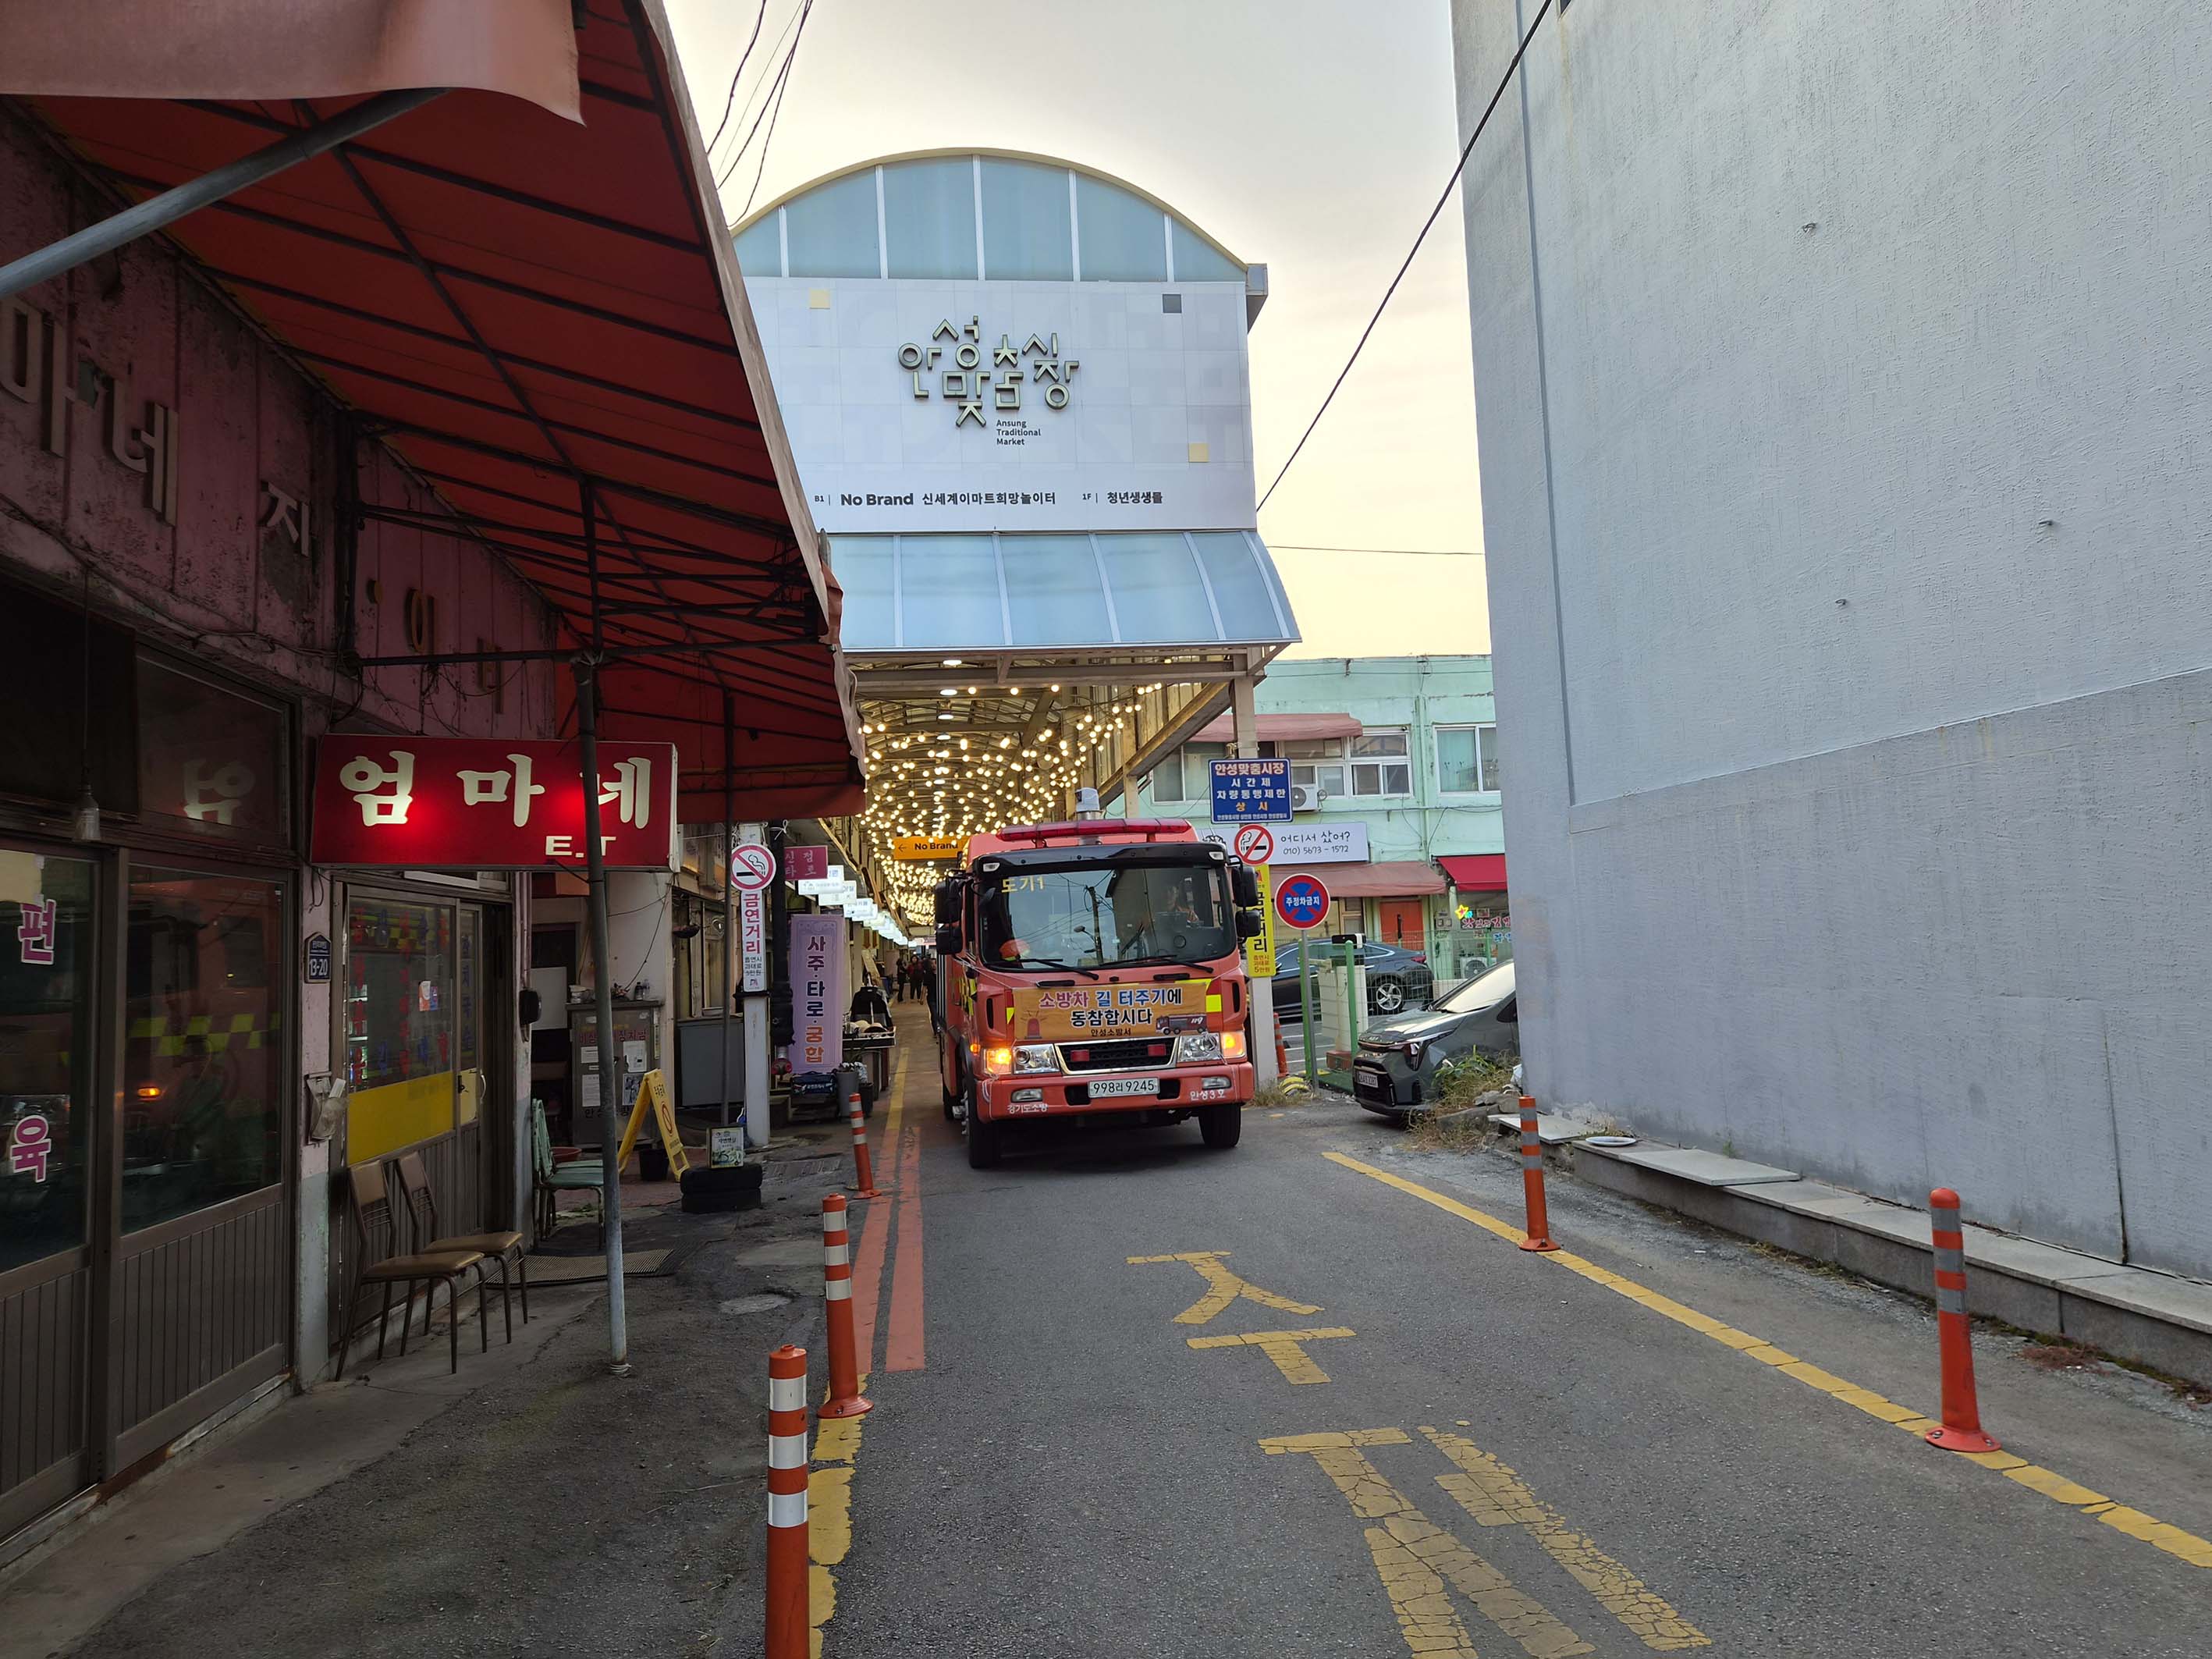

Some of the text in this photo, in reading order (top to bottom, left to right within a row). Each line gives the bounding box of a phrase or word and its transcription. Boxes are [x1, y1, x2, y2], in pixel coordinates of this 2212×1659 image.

[996, 420, 1027, 431] Ansung
[841, 494, 862, 506] No
[866, 493, 914, 506] Brand
[1215, 762, 1285, 776] 안성맞춤시장
[1231, 777, 1271, 787] 시간제
[1216, 789, 1286, 800] 차량통행제한
[1280, 830, 1351, 843] 어디서 샀어?
[1286, 895, 1320, 906] 주정차금지
[744, 893, 761, 954] 금연거리
[1039, 988, 1182, 1008] 소방차 길 터주기에
[1070, 1009, 1152, 1027] 동참합시다
[1091, 1028, 1131, 1037] 안성소방서
